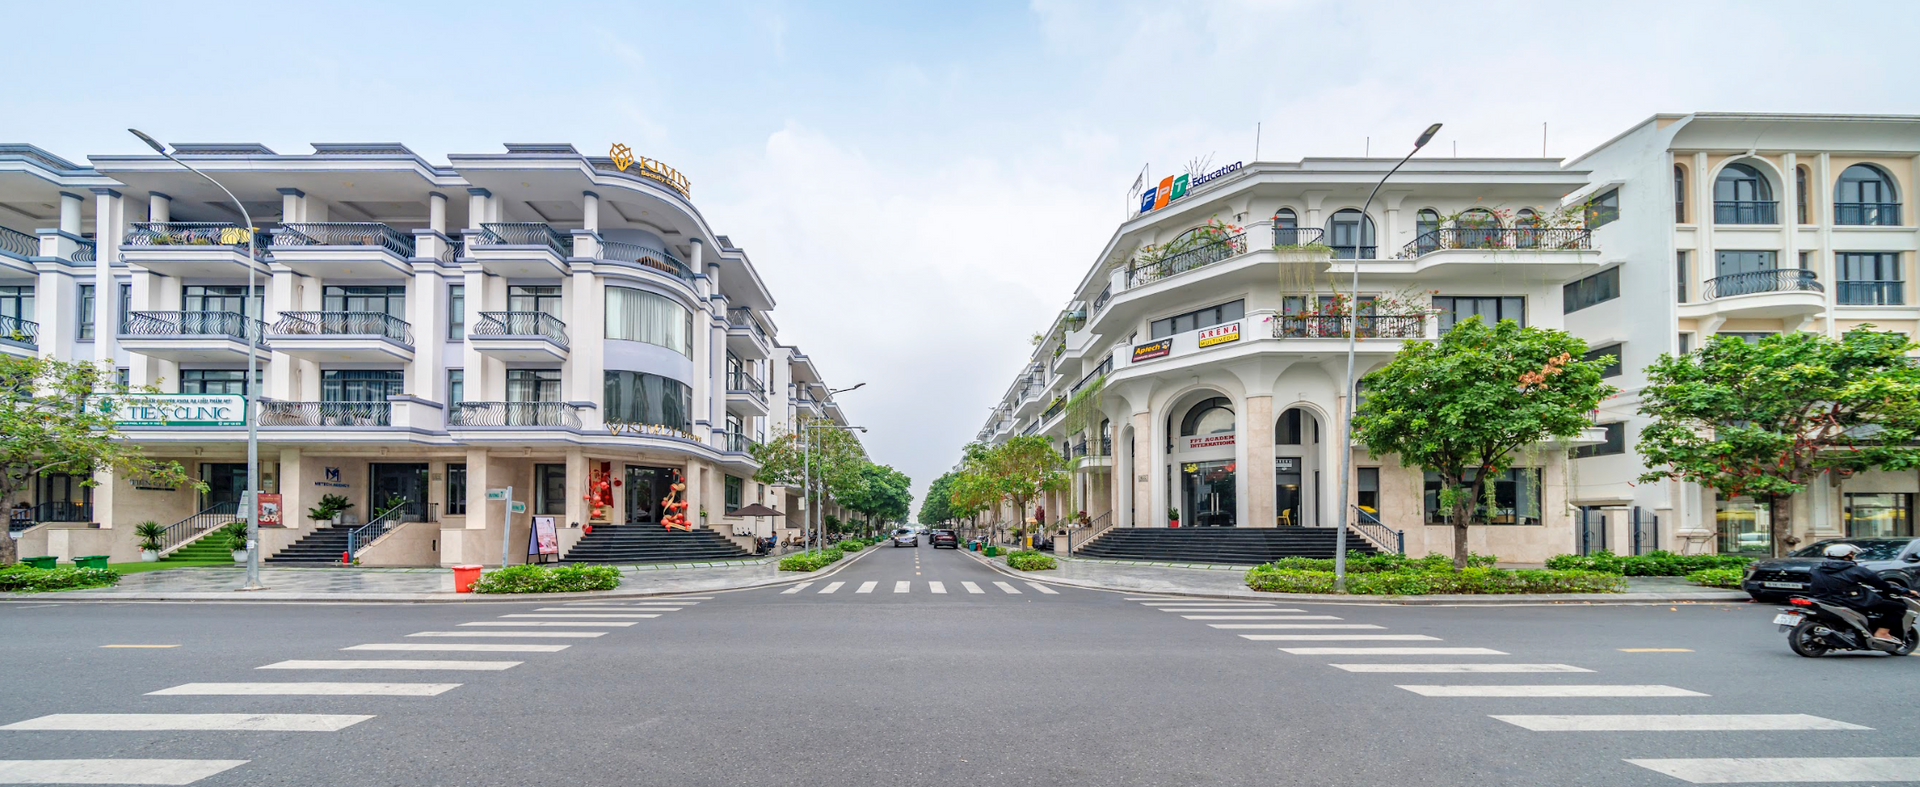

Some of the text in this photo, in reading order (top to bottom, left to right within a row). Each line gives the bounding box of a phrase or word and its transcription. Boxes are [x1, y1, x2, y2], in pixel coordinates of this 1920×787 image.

[641, 170, 666, 183] Beauty
[1141, 160, 1243, 210] FPT Education
[1200, 325, 1238, 339] ARENA
[1200, 335, 1238, 346] MULTIMEDIA
[1135, 343, 1161, 355] Aptech
[174, 407, 231, 420] CLINIC
[626, 421, 680, 438] KIMLY
[1190, 439, 1236, 449] INTERNATIONA
[1205, 434, 1235, 442] ACADEM
[500, 490, 504, 498] 7
